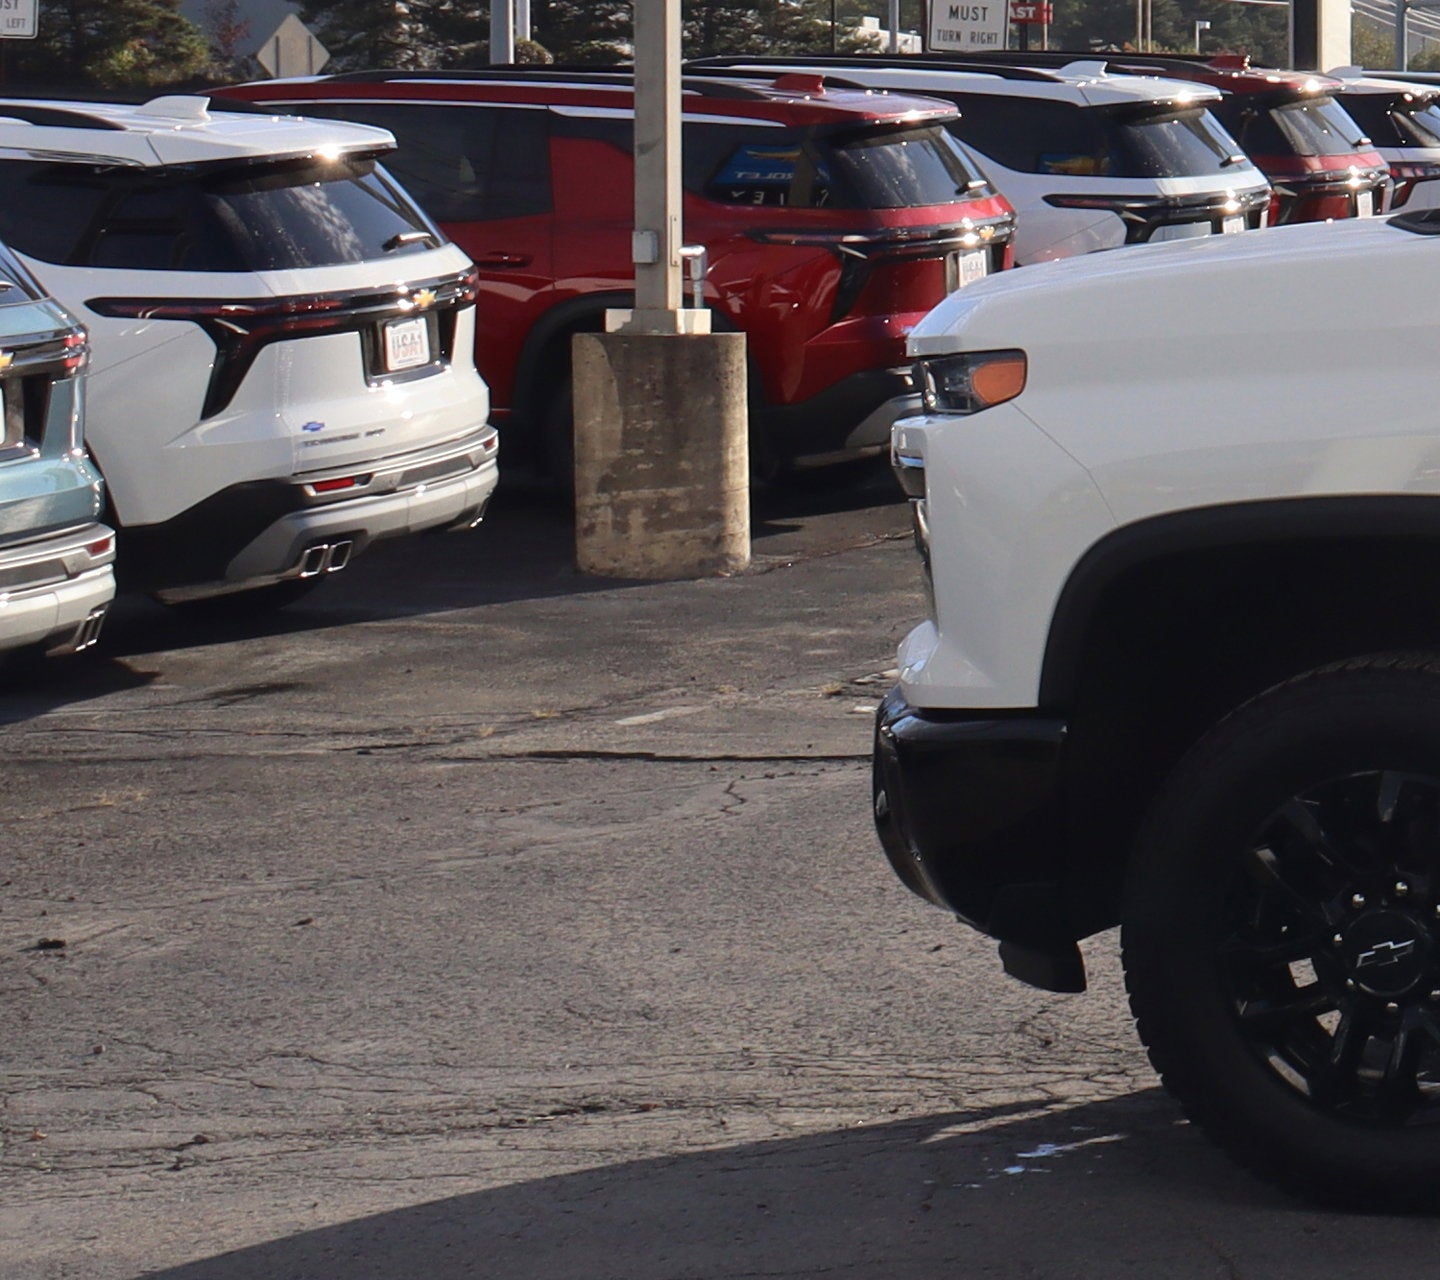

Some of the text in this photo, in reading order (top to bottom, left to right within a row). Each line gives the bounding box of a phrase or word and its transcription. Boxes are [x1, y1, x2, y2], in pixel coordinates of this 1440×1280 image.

[949, 4, 989, 22] MUST
[937, 28, 999, 45] TURN RIGHT
